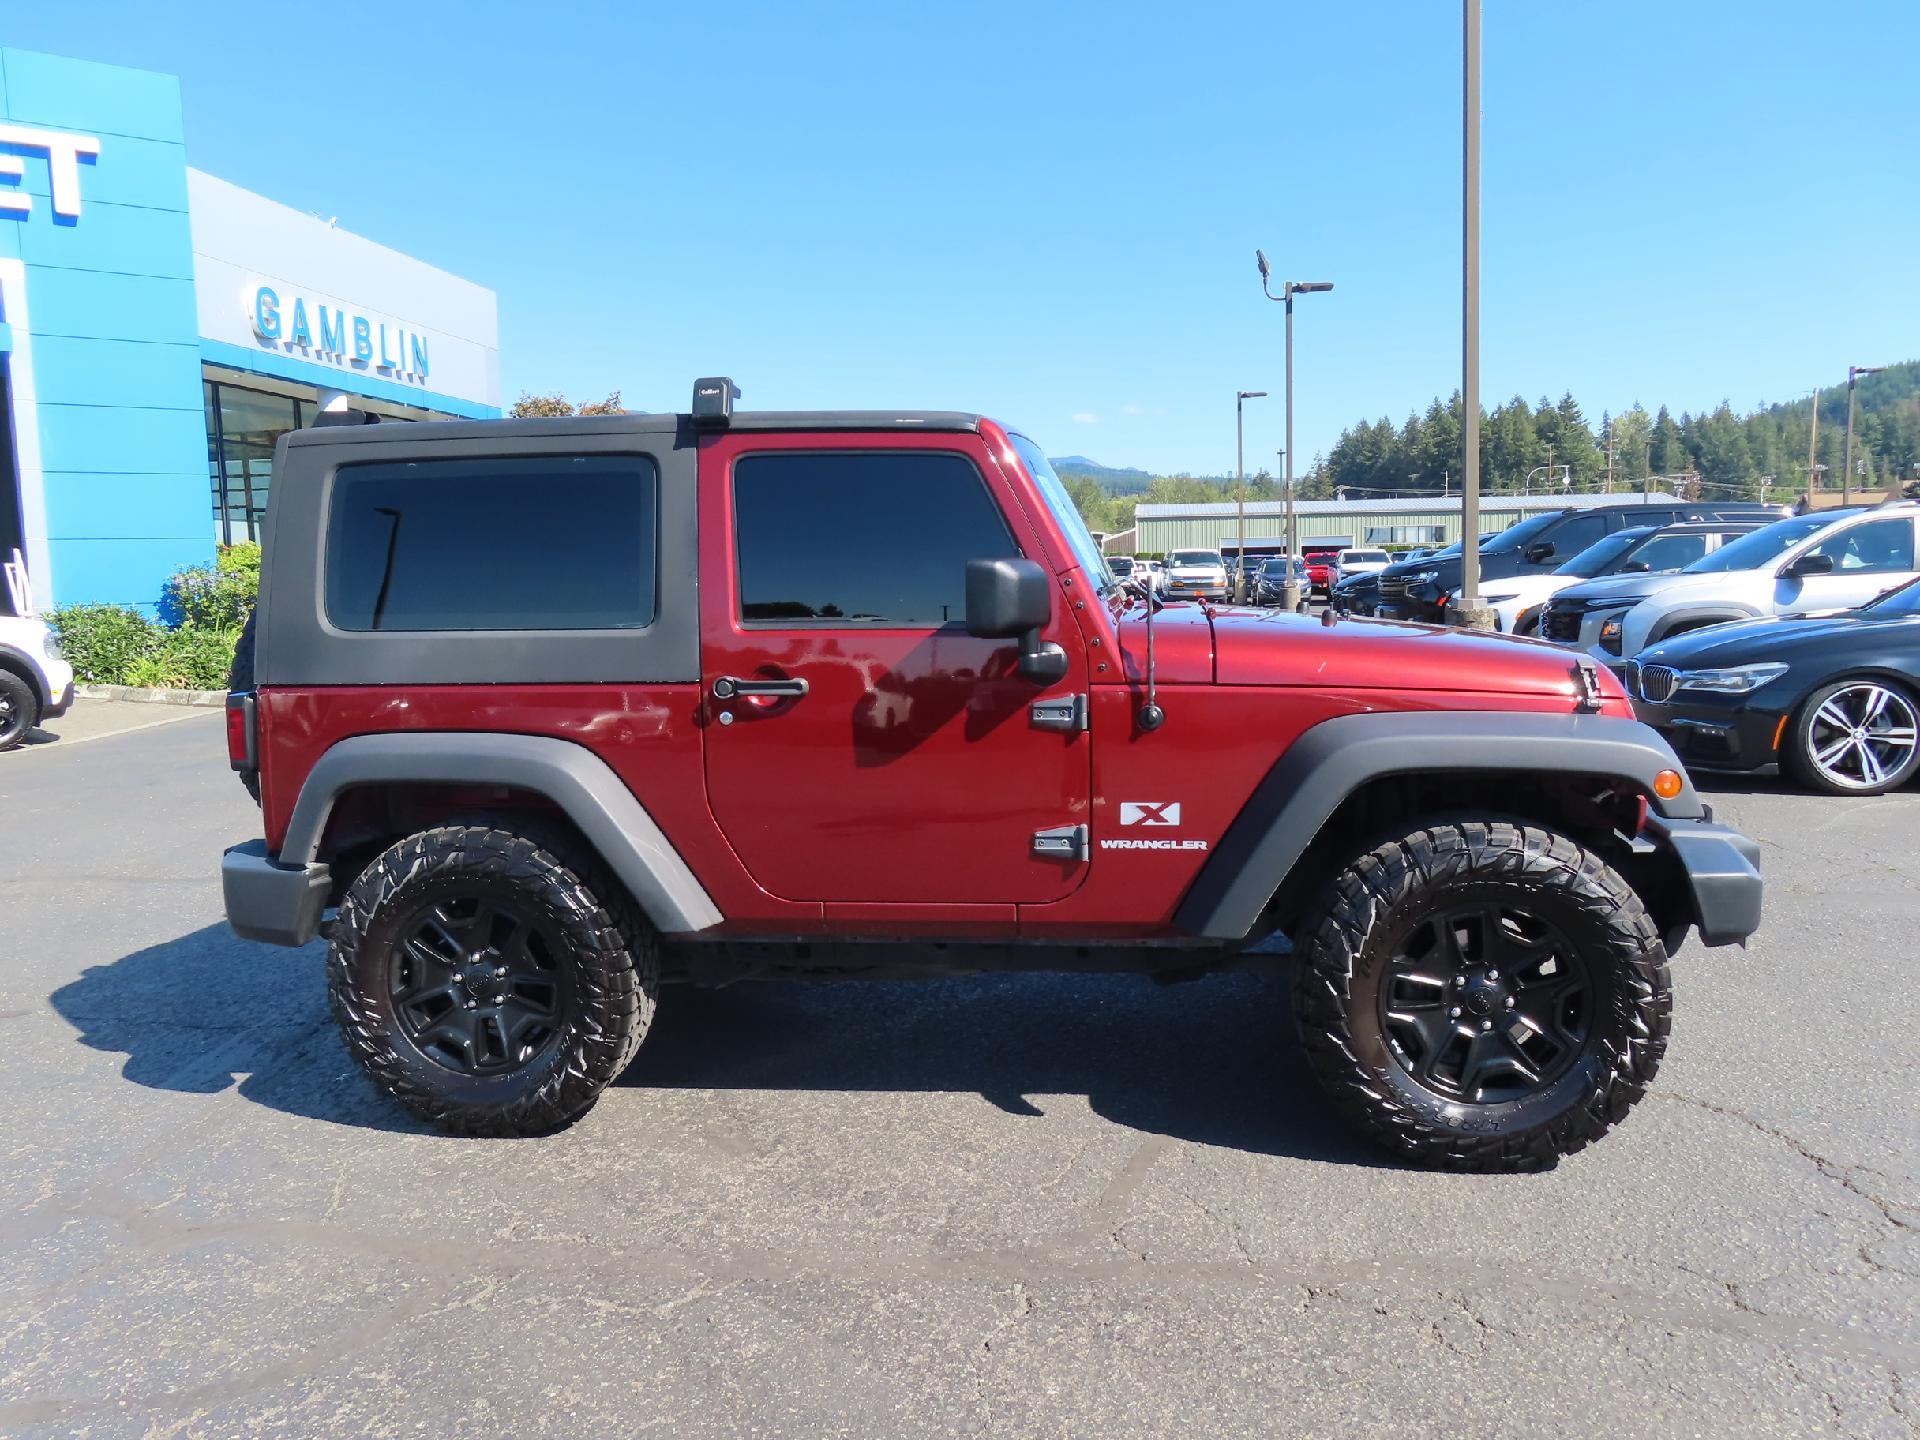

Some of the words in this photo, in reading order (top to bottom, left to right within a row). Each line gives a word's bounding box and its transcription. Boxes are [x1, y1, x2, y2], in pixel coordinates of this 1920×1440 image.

[255, 286, 430, 378] GAMBLIN
[1125, 801, 1179, 826] X
[1100, 839, 1208, 850] WRANGLER
